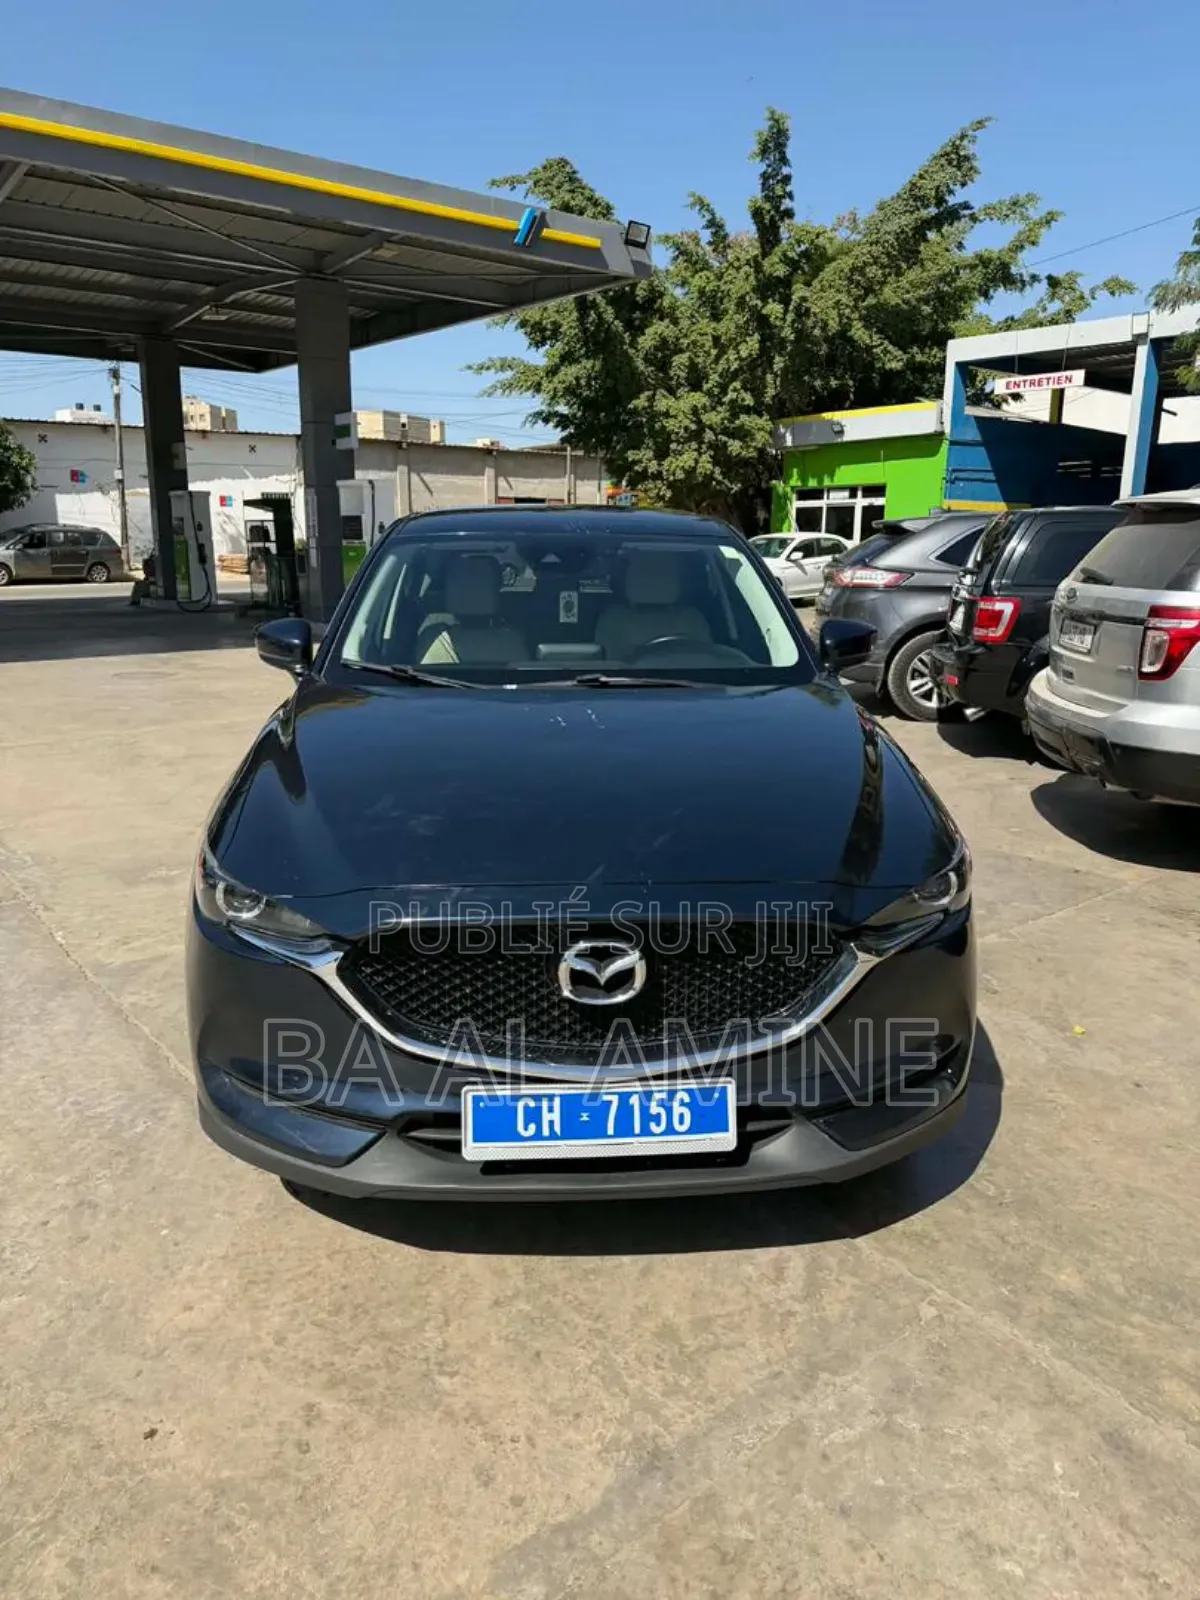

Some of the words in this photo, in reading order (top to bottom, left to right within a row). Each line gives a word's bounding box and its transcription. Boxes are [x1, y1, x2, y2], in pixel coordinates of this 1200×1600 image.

[1005, 374, 1074, 390] ENTRETIEN
[516, 1097, 561, 1138] CH
[602, 1091, 691, 1136] 7156
